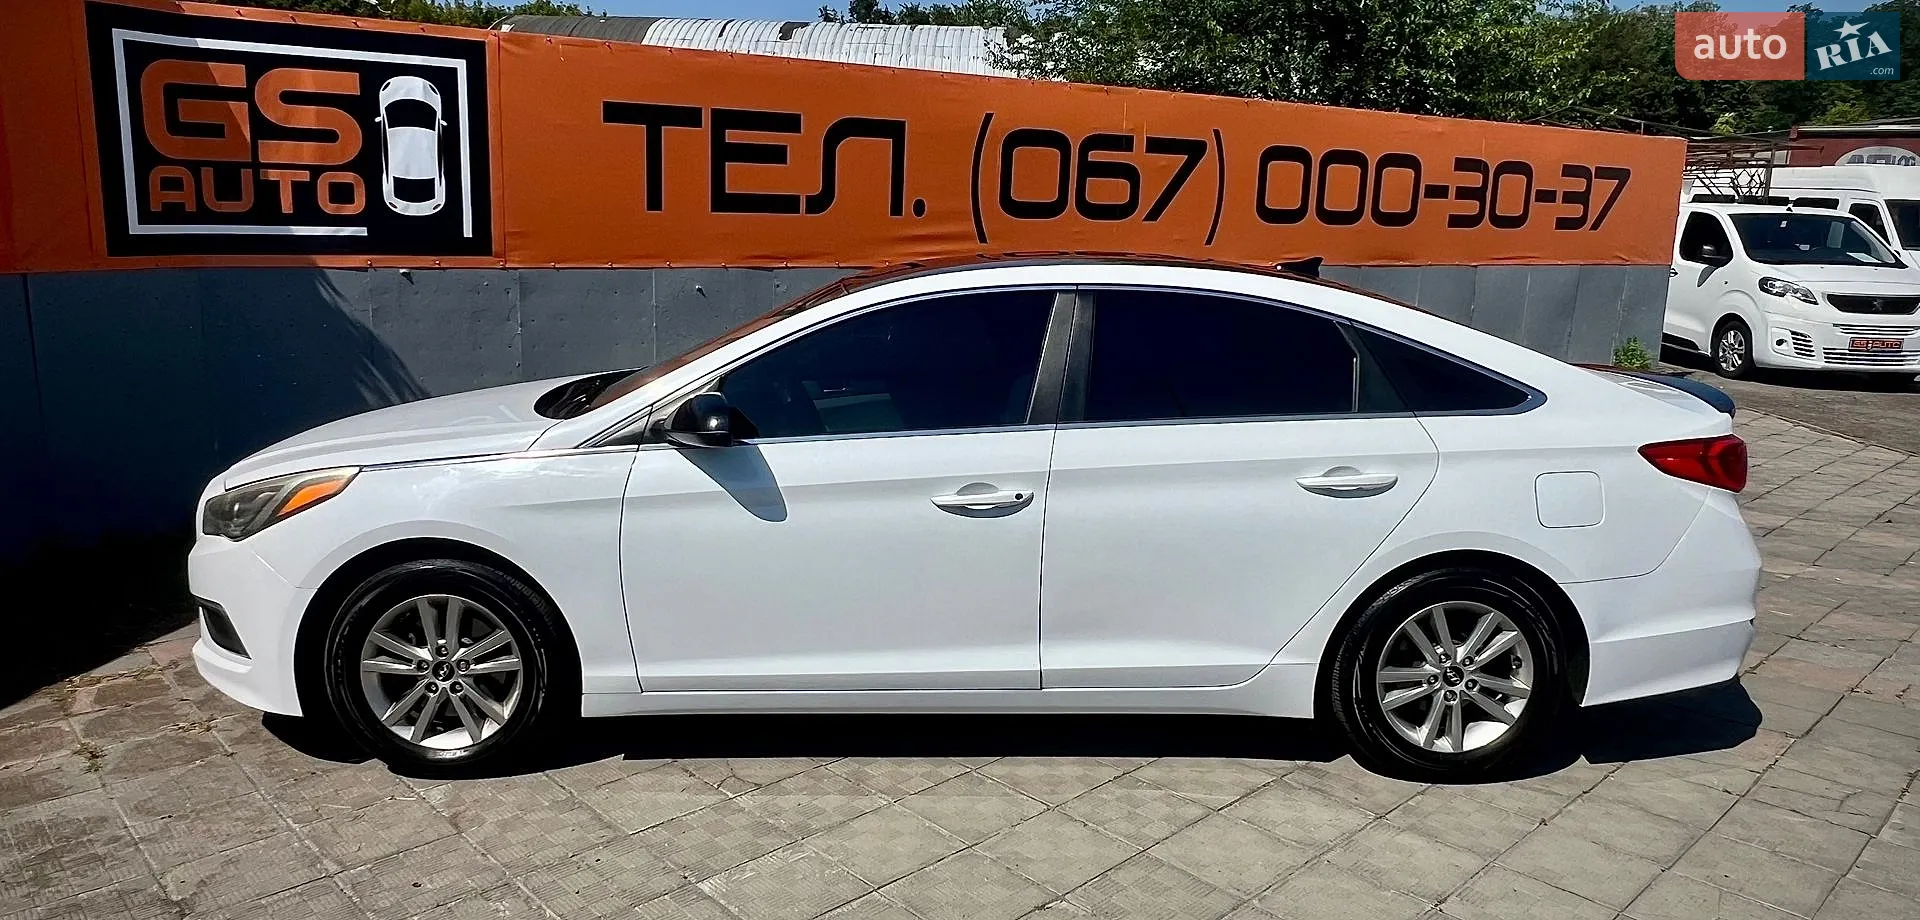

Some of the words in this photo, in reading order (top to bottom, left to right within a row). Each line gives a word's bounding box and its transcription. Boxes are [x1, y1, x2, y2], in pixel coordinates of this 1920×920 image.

[140, 58, 363, 165] GS
[148, 165, 367, 215] AUTO
[602, 100, 927, 219] ТЕЛ.
[971, 112, 1226, 246] (067)
[1255, 144, 1632, 232] 000-30-37
